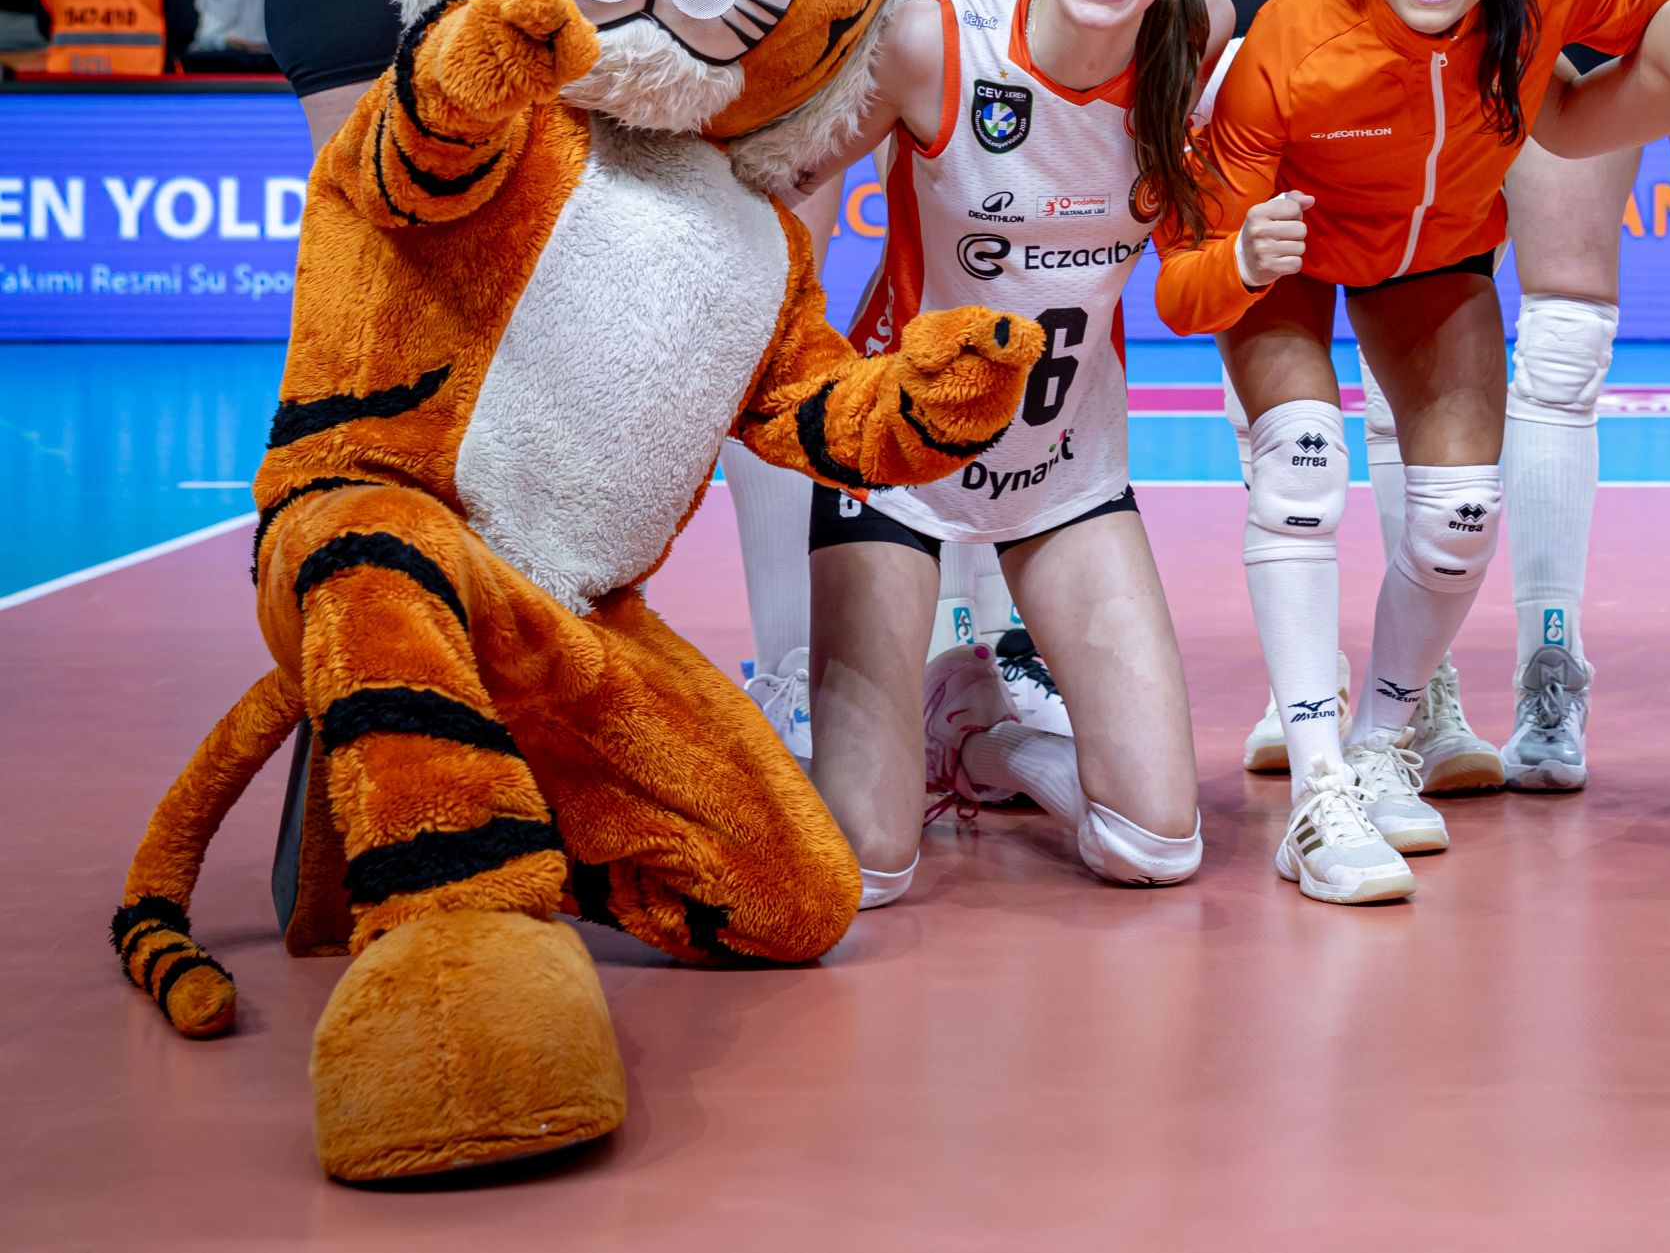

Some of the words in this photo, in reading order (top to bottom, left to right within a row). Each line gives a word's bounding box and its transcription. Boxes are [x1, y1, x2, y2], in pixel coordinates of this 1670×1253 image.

[977, 86, 1003, 99] CEV
[1327, 128, 1392, 140] DECATHLON
[969, 210, 1025, 223] DECATHLON
[0, 263, 84, 295] akımı
[91, 263, 182, 295] Resmi
[189, 263, 226, 294] Su
[1022, 307, 1088, 427] 6
[1292, 455, 1327, 467] errea
[1449, 520, 1484, 532] errea
